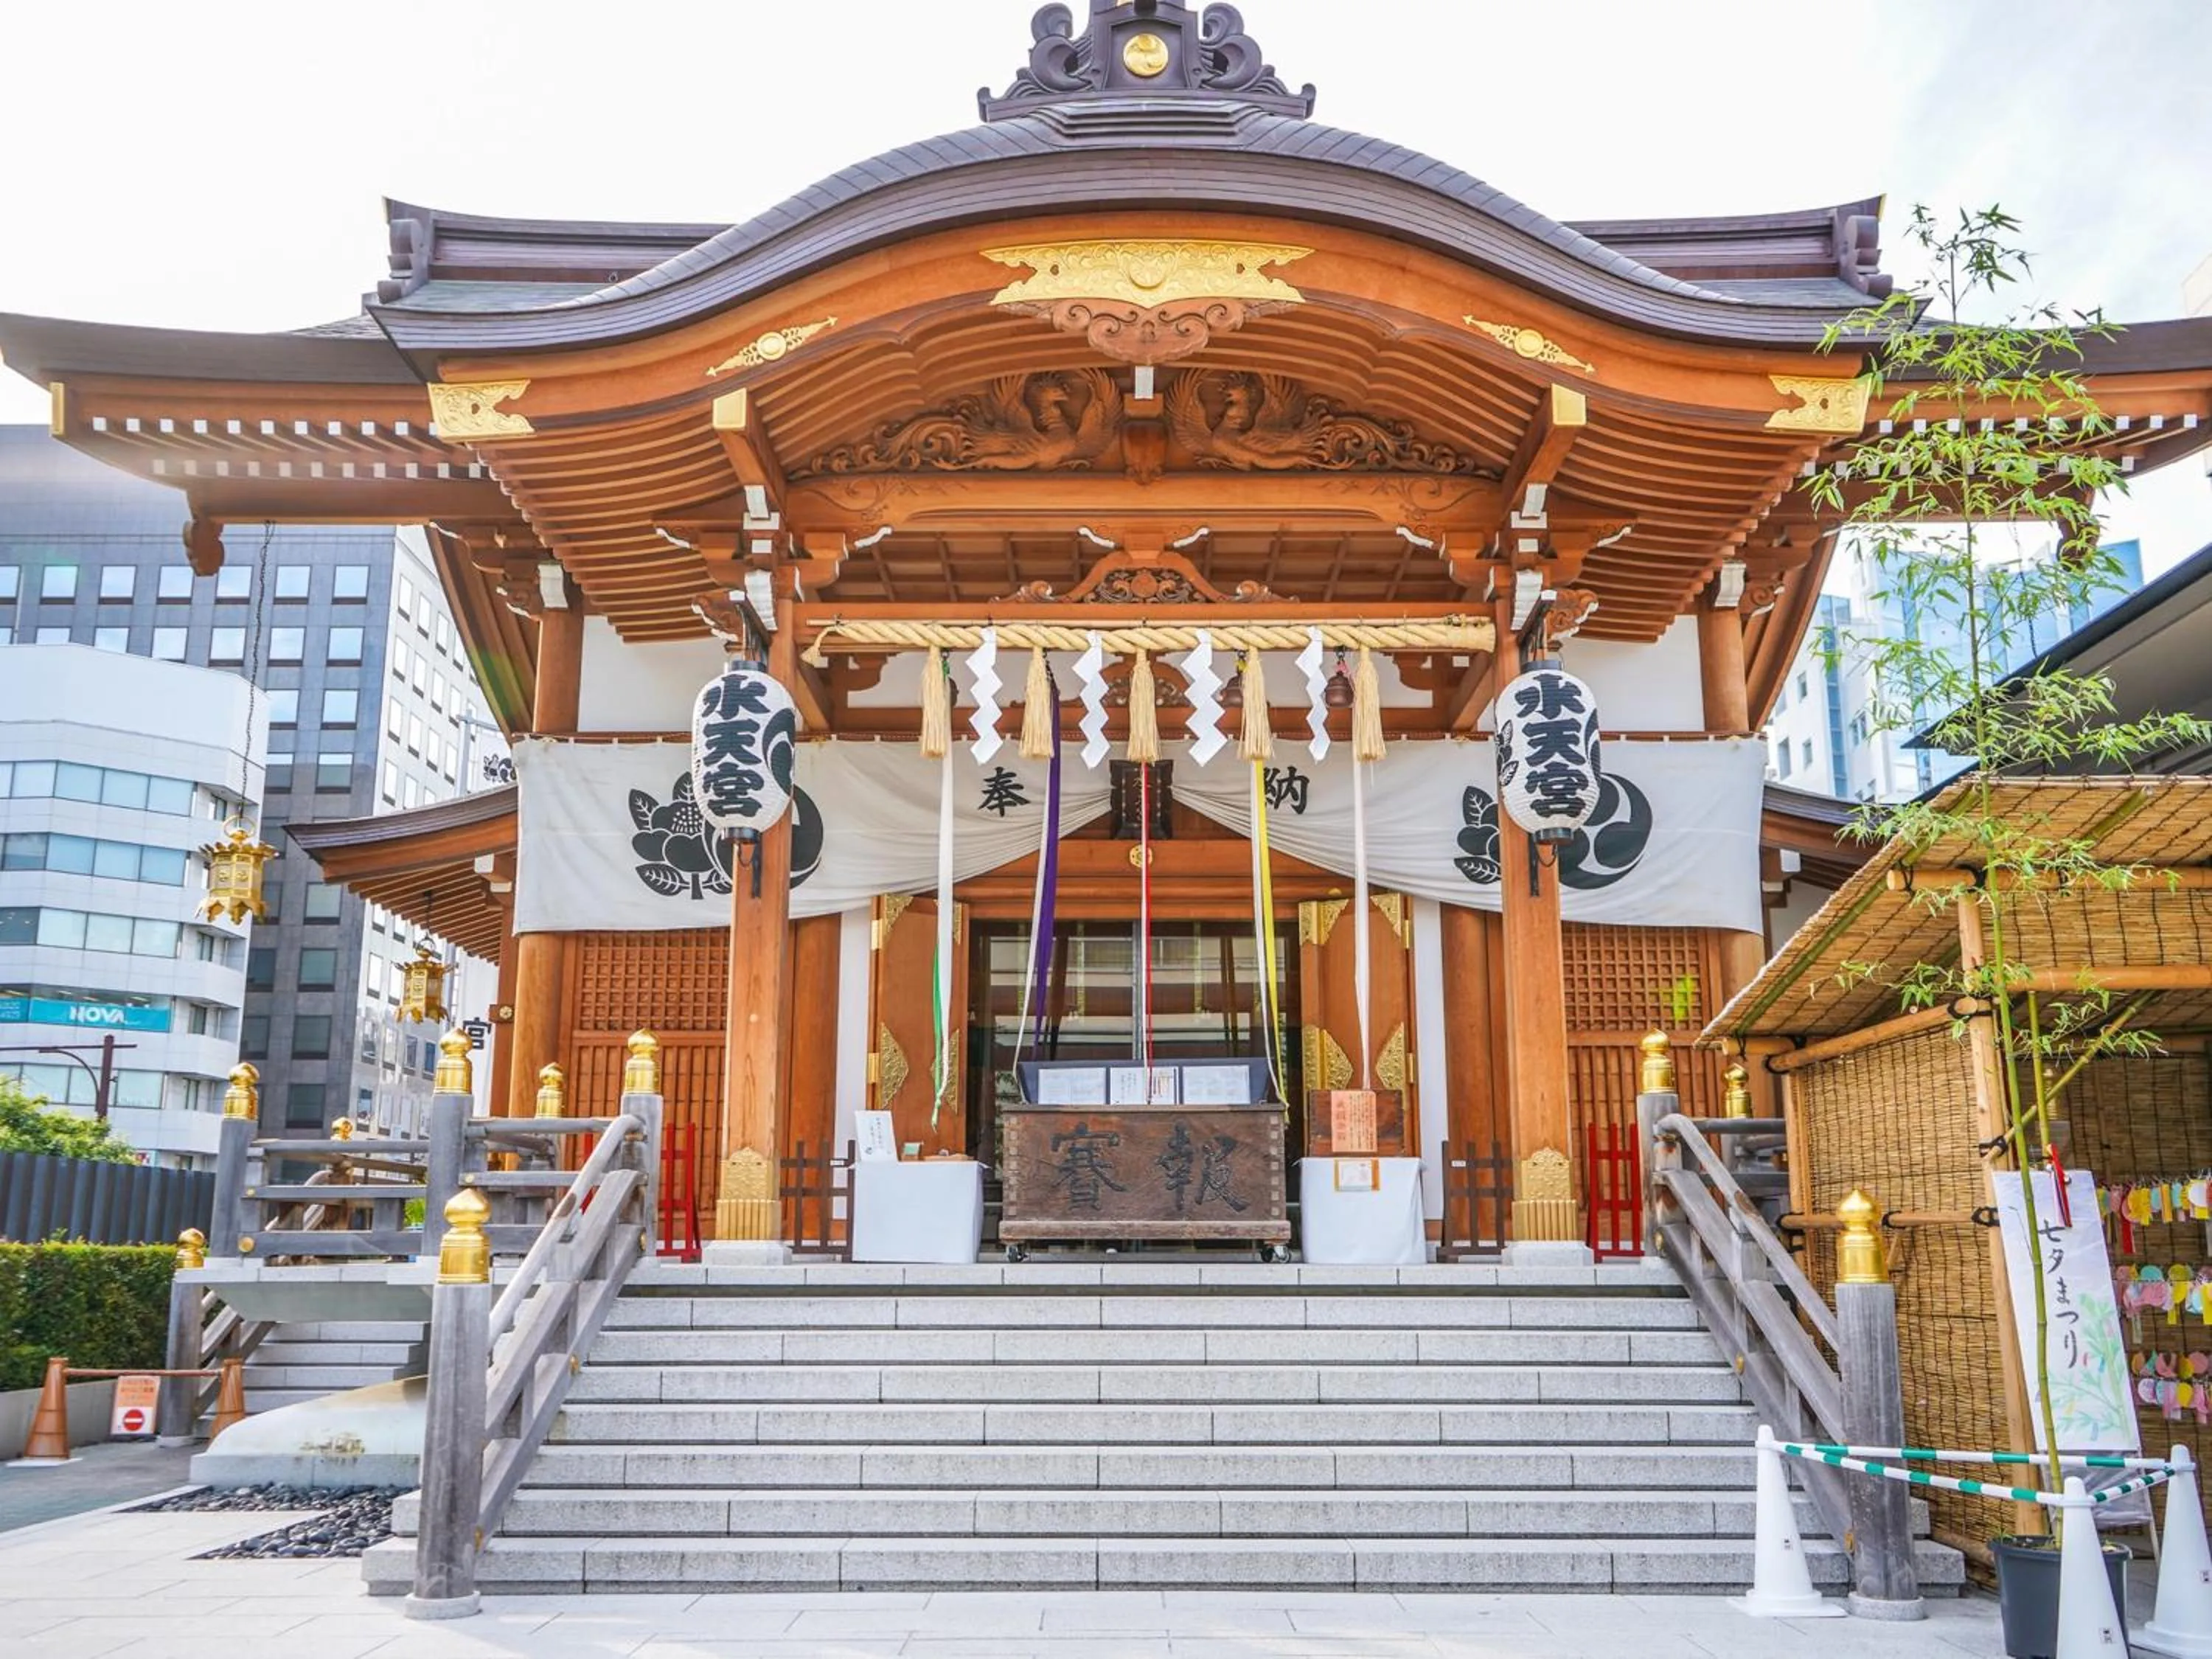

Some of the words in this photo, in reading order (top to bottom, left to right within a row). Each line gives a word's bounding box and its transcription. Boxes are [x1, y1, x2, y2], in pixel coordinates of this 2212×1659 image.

[702, 674, 770, 817] 水天宮
[1515, 674, 1587, 818] 水天宮
[70, 1006, 125, 1023] NOVA
[2038, 1219, 2079, 1368] 七夕まつり
